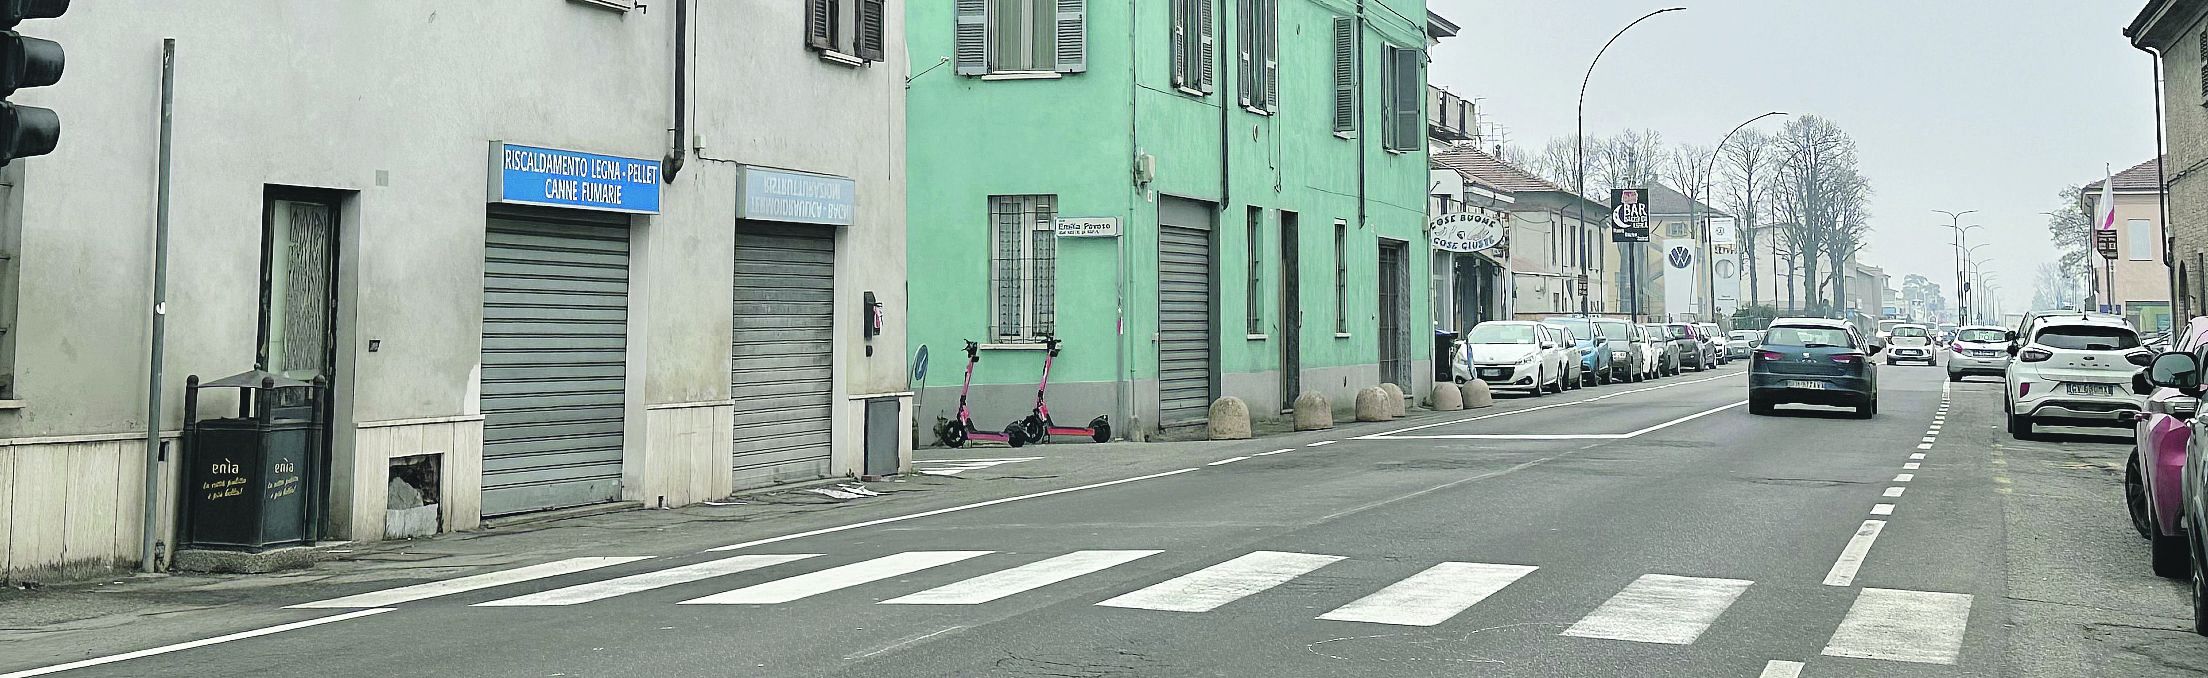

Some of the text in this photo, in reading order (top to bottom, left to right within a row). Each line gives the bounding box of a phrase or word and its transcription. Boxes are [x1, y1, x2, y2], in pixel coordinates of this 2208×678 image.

[505, 149, 588, 179] RISCALDAMENTO
[591, 158, 621, 181] LEGNA
[627, 163, 658, 185] PELLET
[545, 178, 622, 205] CANNE FUMARIE
[1623, 202, 1648, 217] BAR
[1430, 214, 1496, 231] COSE BUONE
[1433, 235, 1495, 250] COSE GIUSTE
[212, 457, 239, 474] enìa
[274, 457, 294, 473] enìa
